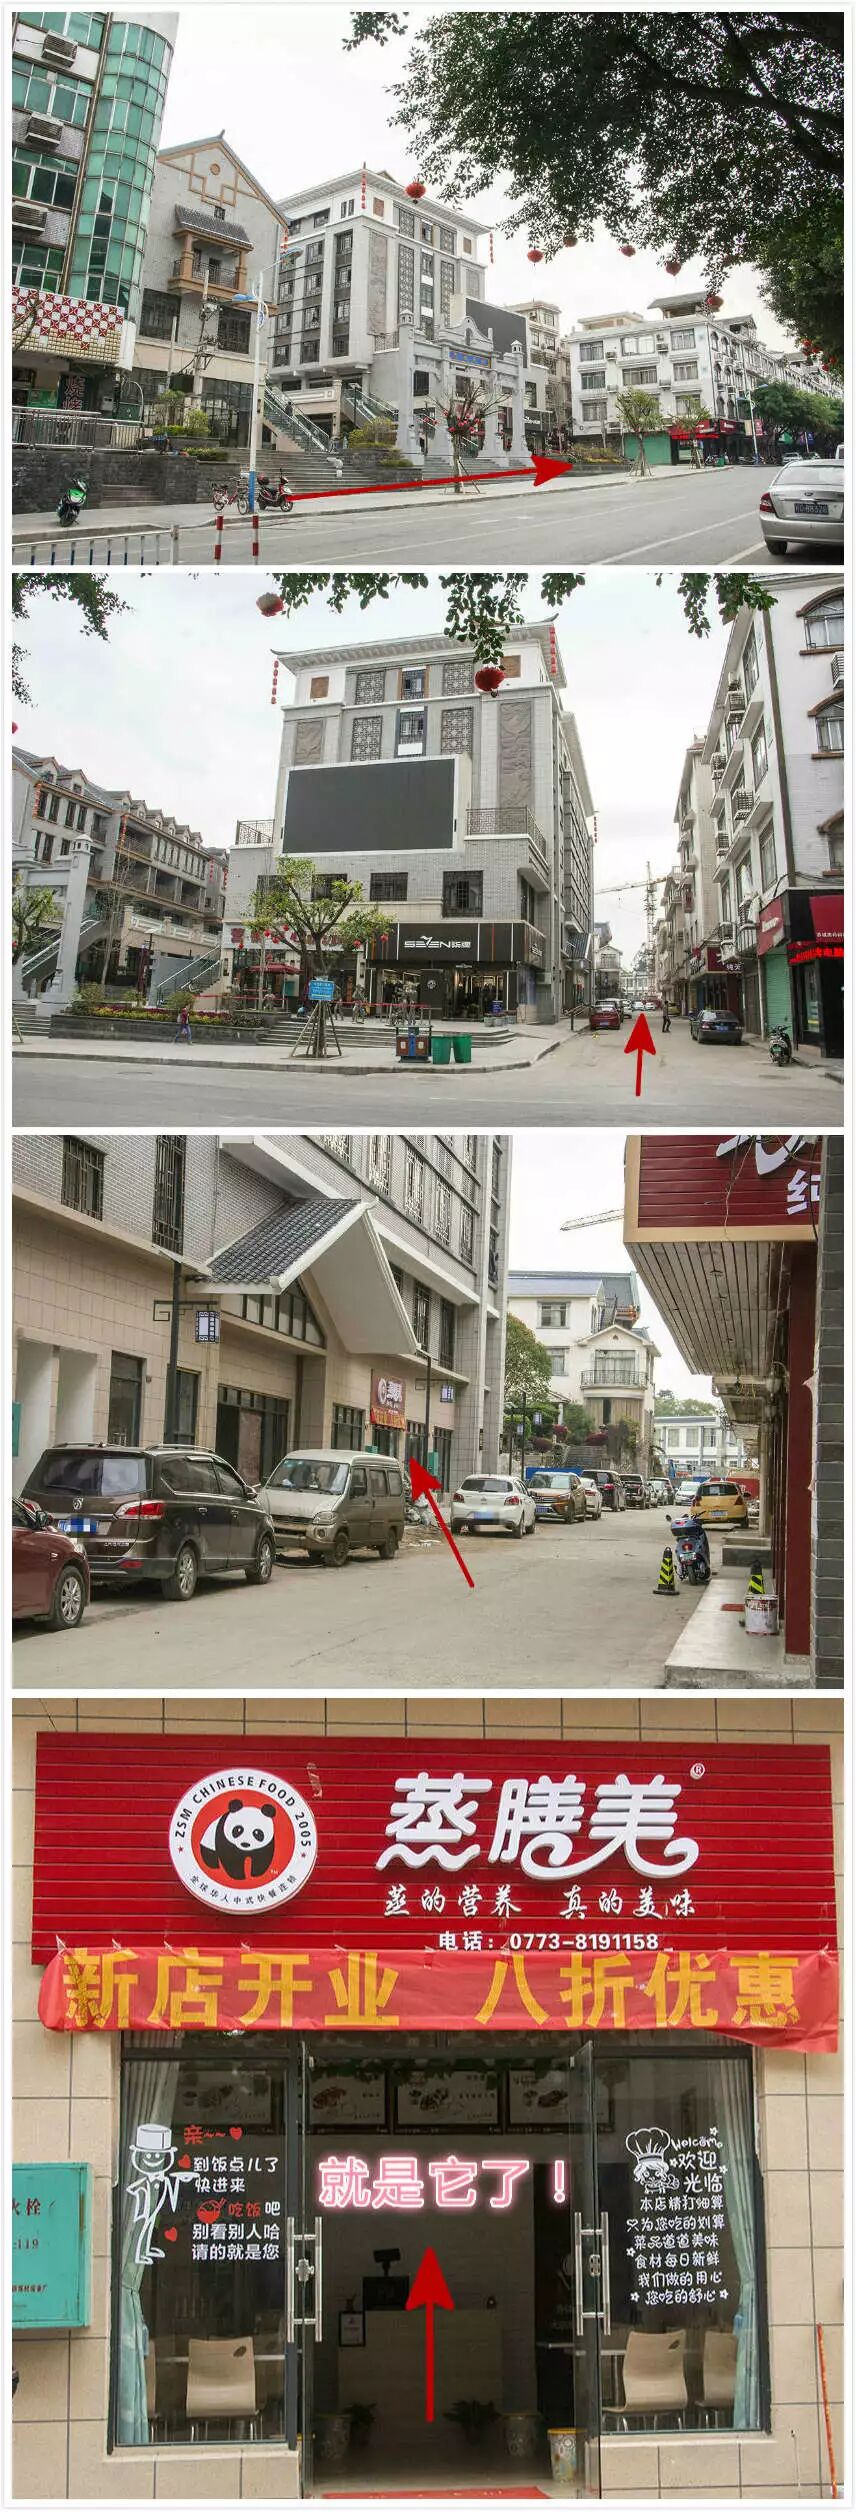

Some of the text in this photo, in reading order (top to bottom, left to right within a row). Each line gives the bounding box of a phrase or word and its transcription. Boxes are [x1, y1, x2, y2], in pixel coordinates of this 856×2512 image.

[175, 1775, 311, 1846] ZSM CHINESE FOOD 2005
[375, 1772, 699, 1881] 蒸膳美
[384, 1884, 695, 1920] 蒸的营养 真的美味
[509, 1933, 658, 1950] 0773-8191158
[63, 1948, 799, 2028] 新店开业 八折优惠
[193, 2156, 279, 2172] 到饭点儿了
[678, 2151, 717, 2170] 欢迎
[195, 2177, 245, 2193] 快进来
[684, 2172, 722, 2193] 光临
[228, 2201, 281, 2217] 吃饭吧
[640, 2195, 724, 2212] 本店精打细算
[192, 2223, 280, 2240] 别看别人哈
[626, 2214, 725, 2232] 只为您吃的划算
[634, 2232, 719, 2250] 菜品道道美味
[191, 2243, 279, 2260] 请的就是您
[634, 2251, 720, 2269] 食材每日新鲜
[638, 2271, 722, 2287] 我们做的用心
[645, 2288, 716, 2305] 您吃的舒心
